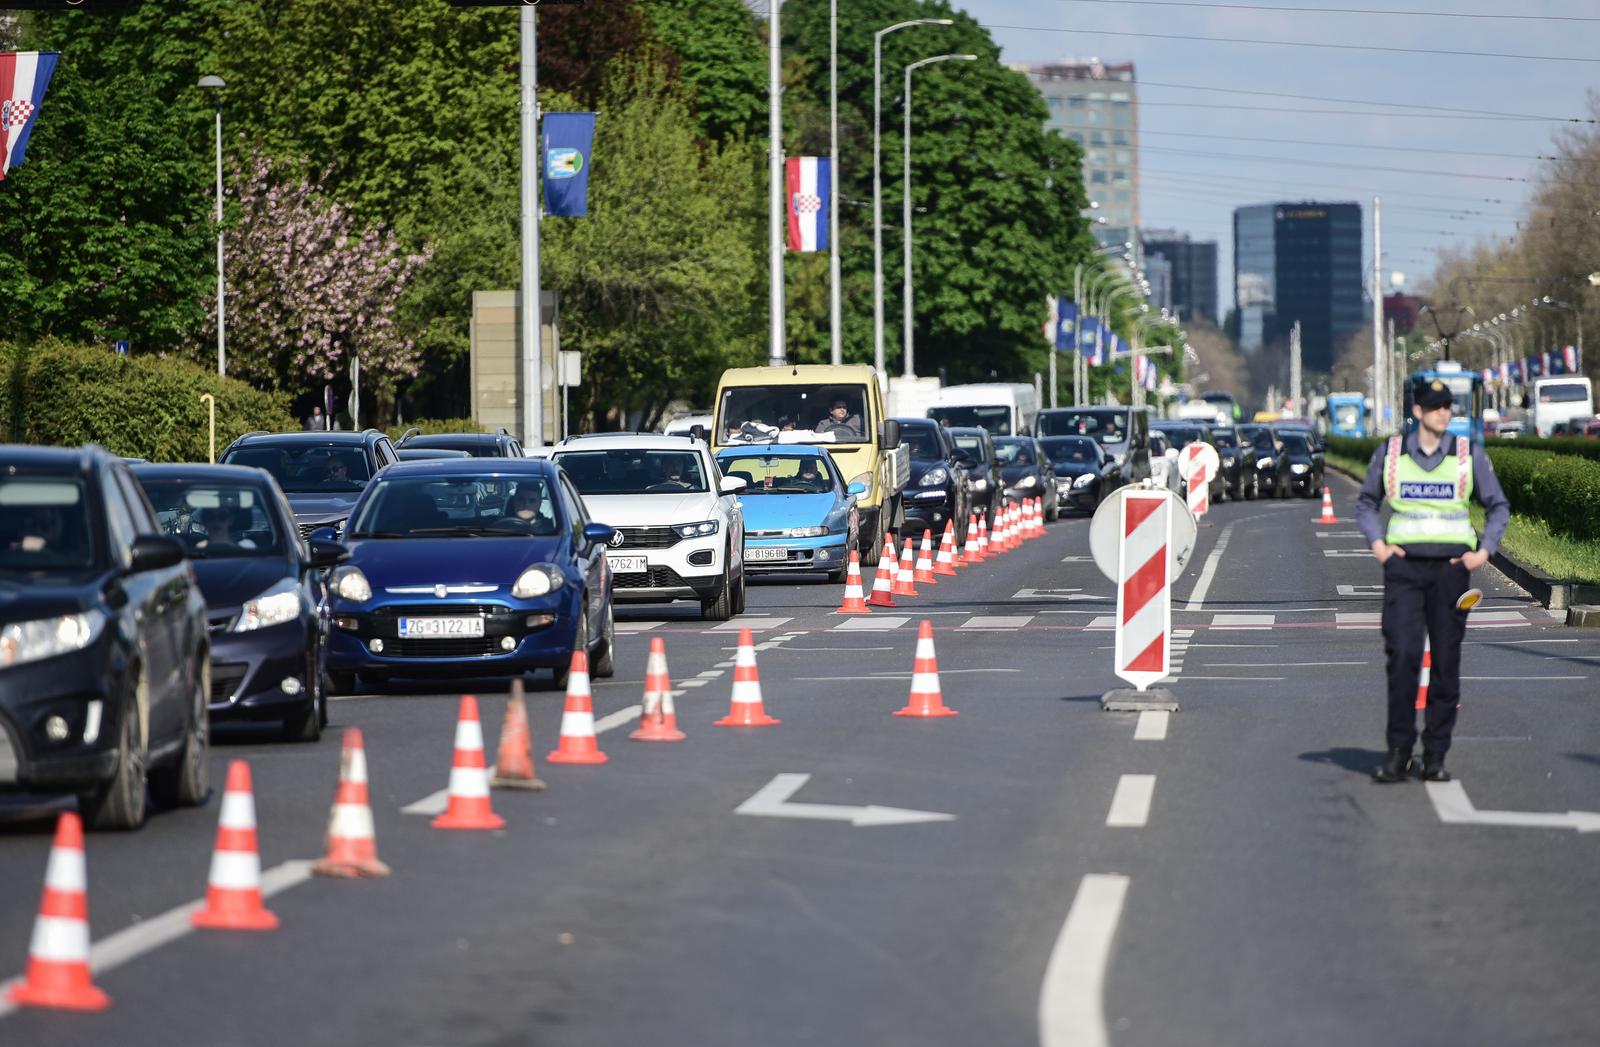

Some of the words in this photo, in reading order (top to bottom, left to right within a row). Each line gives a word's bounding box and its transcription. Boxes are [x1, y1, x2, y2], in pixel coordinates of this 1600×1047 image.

[1401, 484, 1453, 497] POLICIJA
[755, 549, 775, 558] 8196
[609, 558, 632, 569] 4762
[408, 620, 424, 633] ZG
[432, 620, 463, 633] 3122
